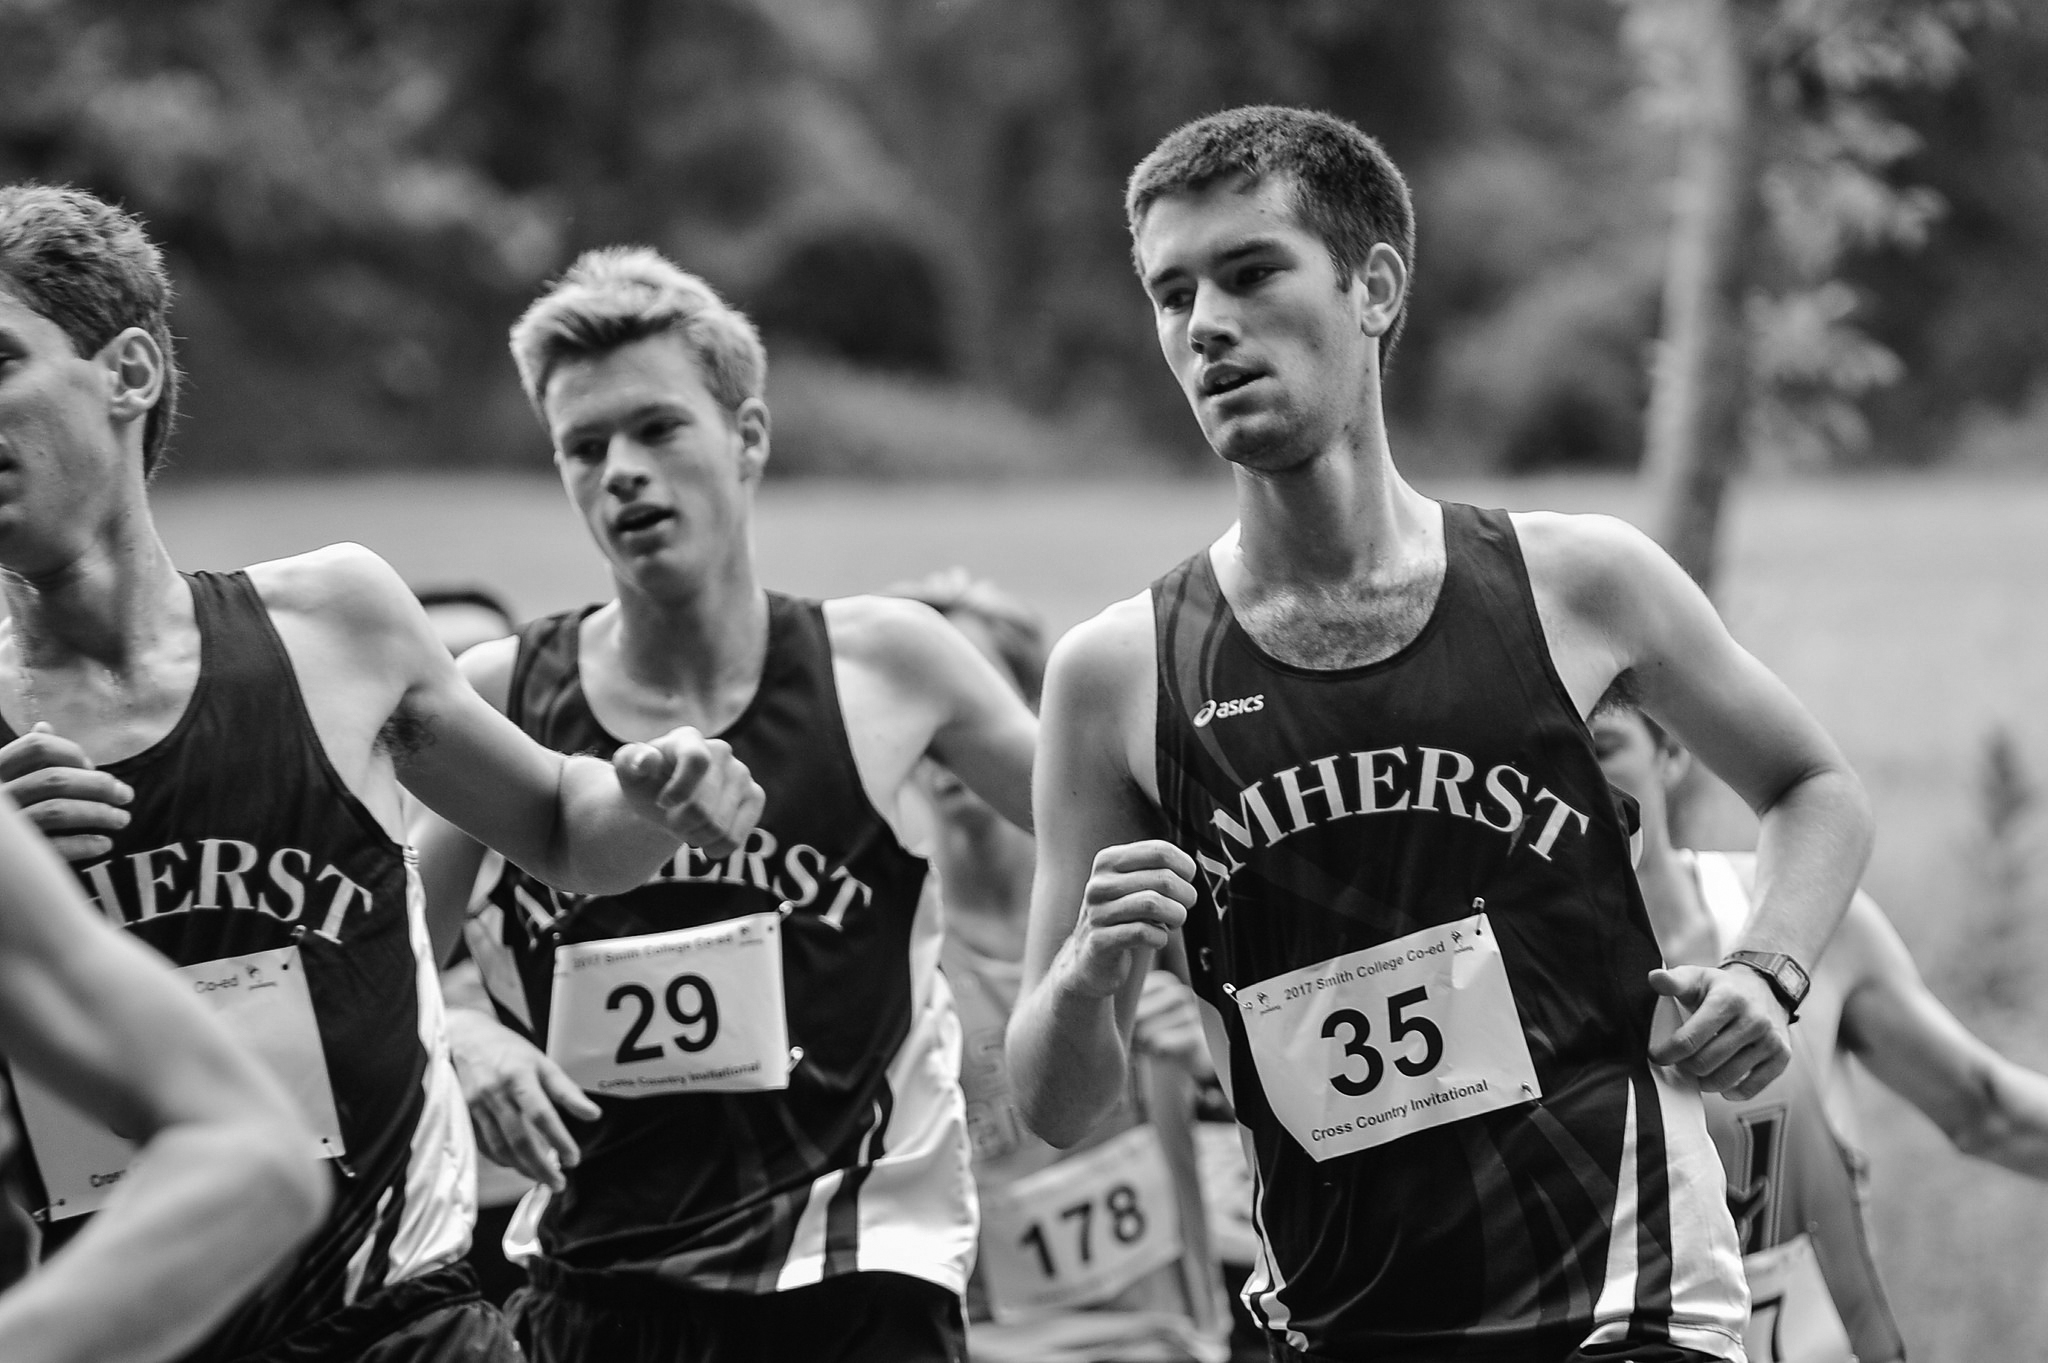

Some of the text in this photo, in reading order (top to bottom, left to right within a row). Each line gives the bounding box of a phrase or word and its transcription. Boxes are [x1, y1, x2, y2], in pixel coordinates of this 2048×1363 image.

[1216, 694, 1264, 718] asics
[1196, 746, 1590, 921] AMHERST
[194, 973, 239, 993] Co-ed
[1284, 941, 1446, 1001] 2017 Smith College Co-ed
[605, 974, 719, 1064] 29
[1320, 985, 1444, 1097] 35
[1311, 1079, 1489, 1142] Cross Country Invitational
[1017, 1185, 1146, 1280] 178
